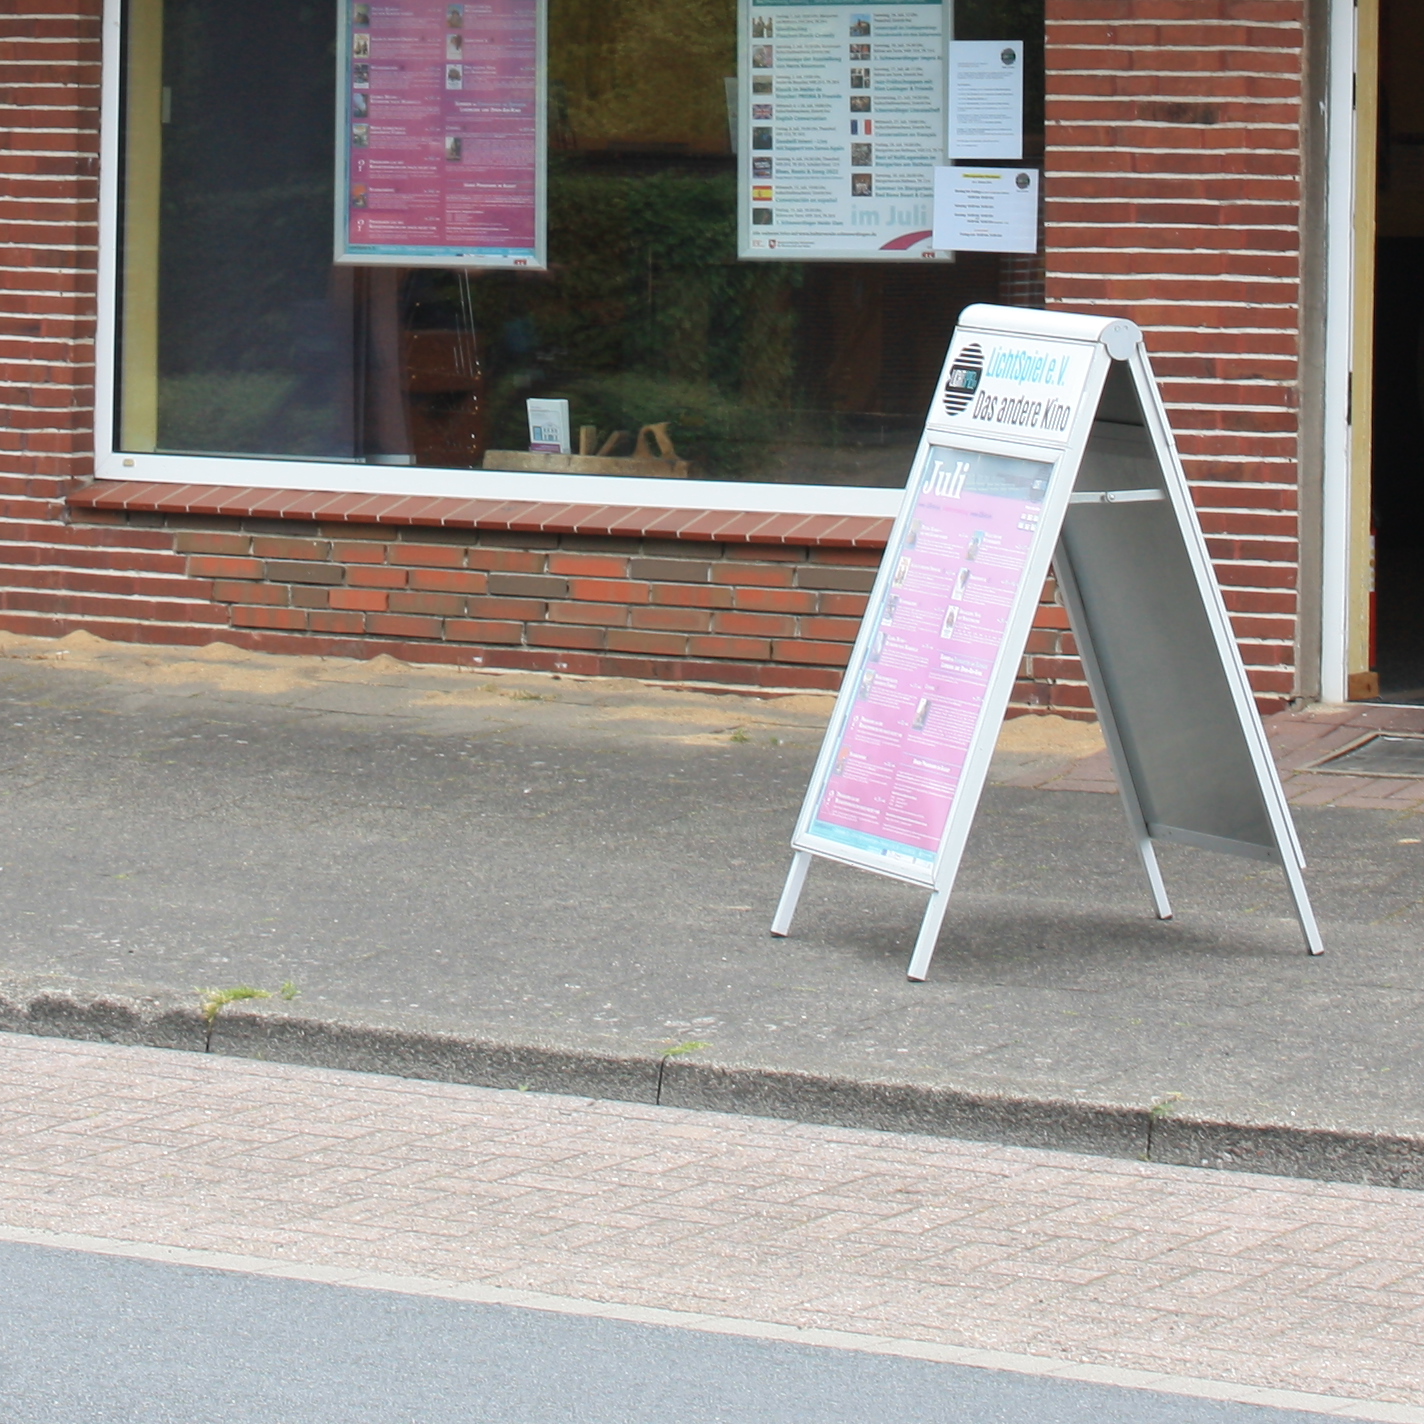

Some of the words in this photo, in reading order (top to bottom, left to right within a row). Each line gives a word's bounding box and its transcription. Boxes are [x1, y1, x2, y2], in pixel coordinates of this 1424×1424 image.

[850, 204, 881, 226] im
[885, 203, 928, 227] Juli
[986, 346, 1049, 385] LichtSpiel
[973, 389, 998, 421] Das
[996, 395, 1042, 428] andere
[1040, 398, 1071, 432] Kino
[922, 460, 970, 499] Juli
